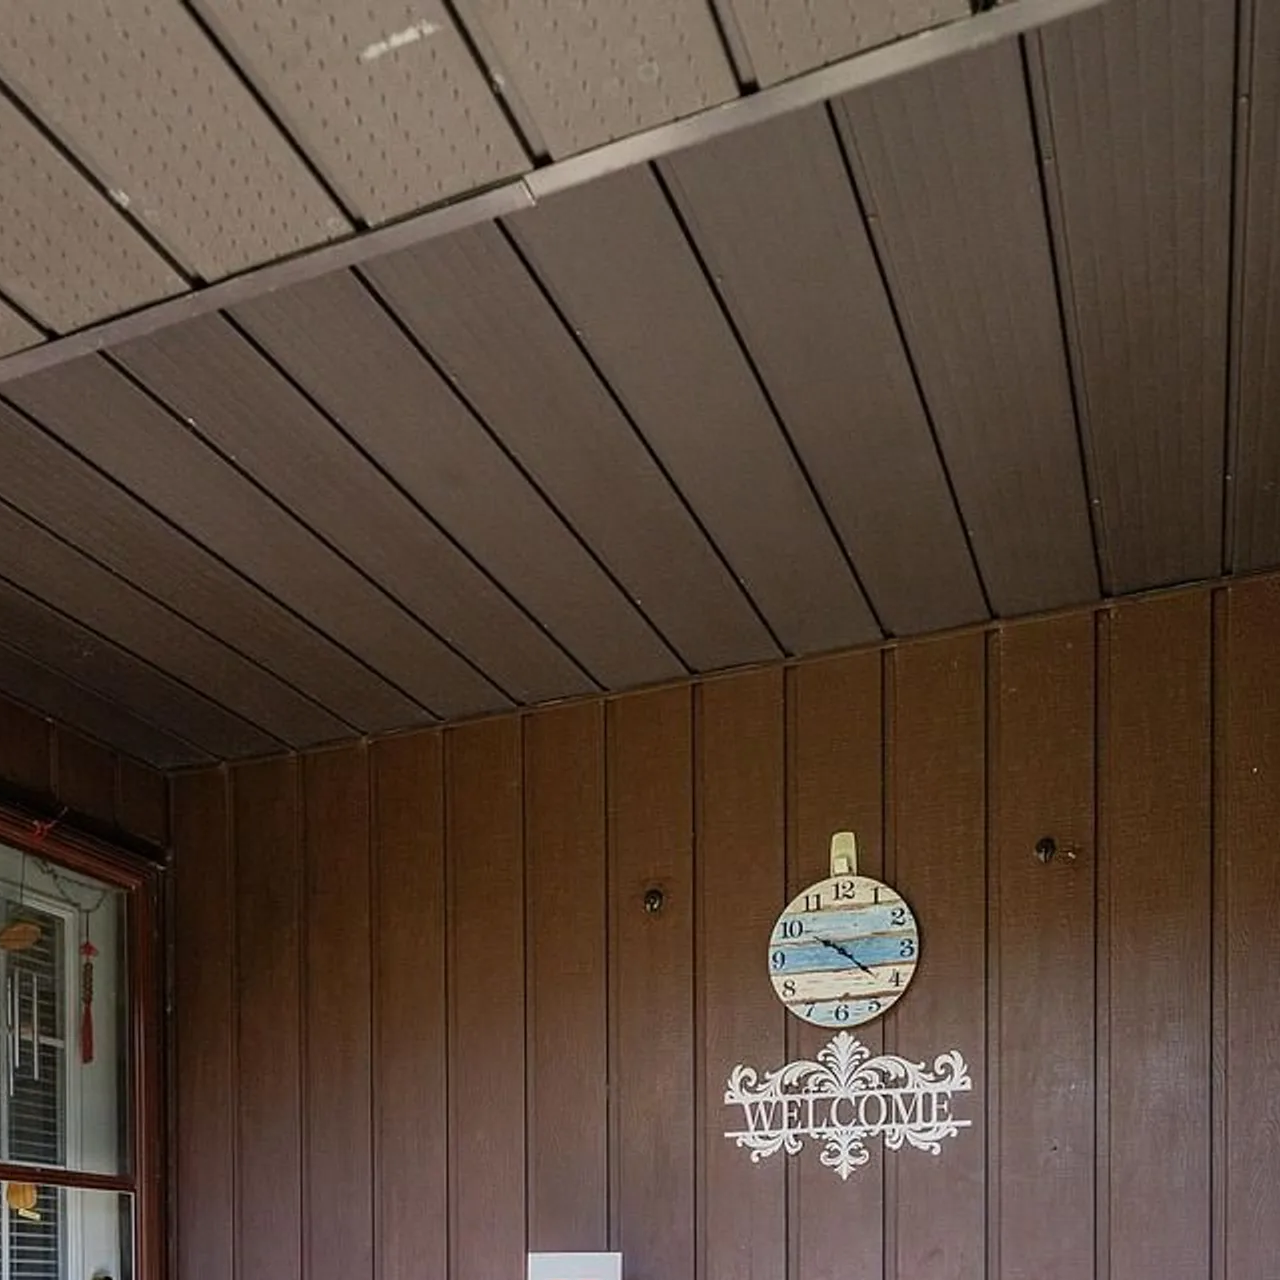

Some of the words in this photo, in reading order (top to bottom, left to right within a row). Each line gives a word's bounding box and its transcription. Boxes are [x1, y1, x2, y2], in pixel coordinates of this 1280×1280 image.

[832, 880, 855, 900] 12
[871, 887, 880, 905] 1
[804, 894, 822, 912] 11
[890, 908, 906, 926] 2
[781, 920, 803, 939] 10
[900, 939, 914, 957] 3
[772, 951, 785, 970] 9
[888, 968, 904, 987] 4
[782, 979, 796, 998] 8
[804, 1001, 816, 1018] 7
[834, 1004, 849, 1021] 6
[741, 1089, 954, 1134] WELCOME
